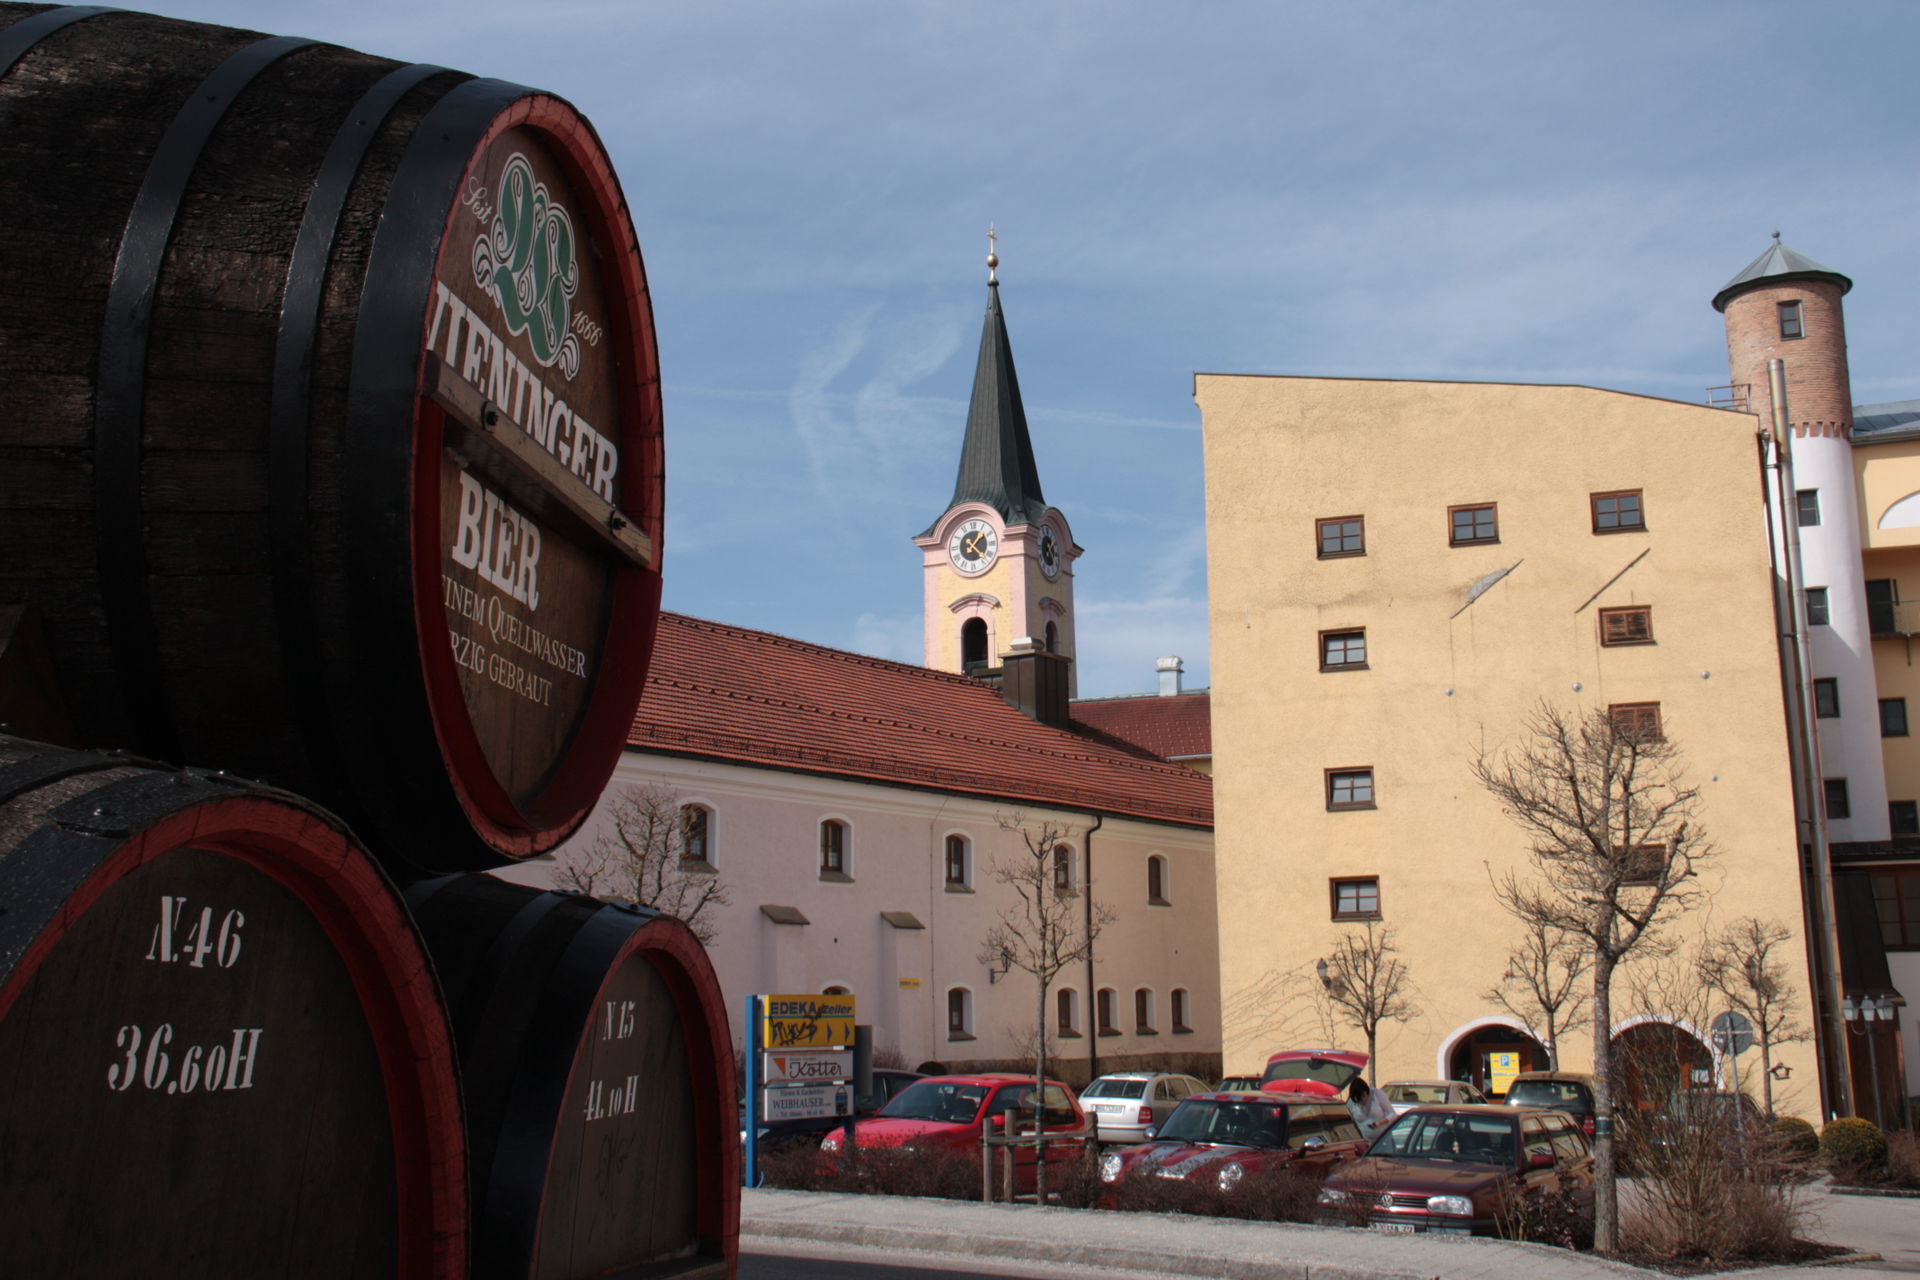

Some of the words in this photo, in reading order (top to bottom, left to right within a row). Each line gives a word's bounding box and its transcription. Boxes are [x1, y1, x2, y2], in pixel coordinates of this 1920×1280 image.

[463, 176, 492, 225] Seit
[571, 310, 602, 347] 1666
[452, 469, 541, 612] BIER
[441, 574, 486, 626] INEM
[489, 652, 552, 706] GEBRAUT
[770, 1001, 817, 1014] EDEKA
